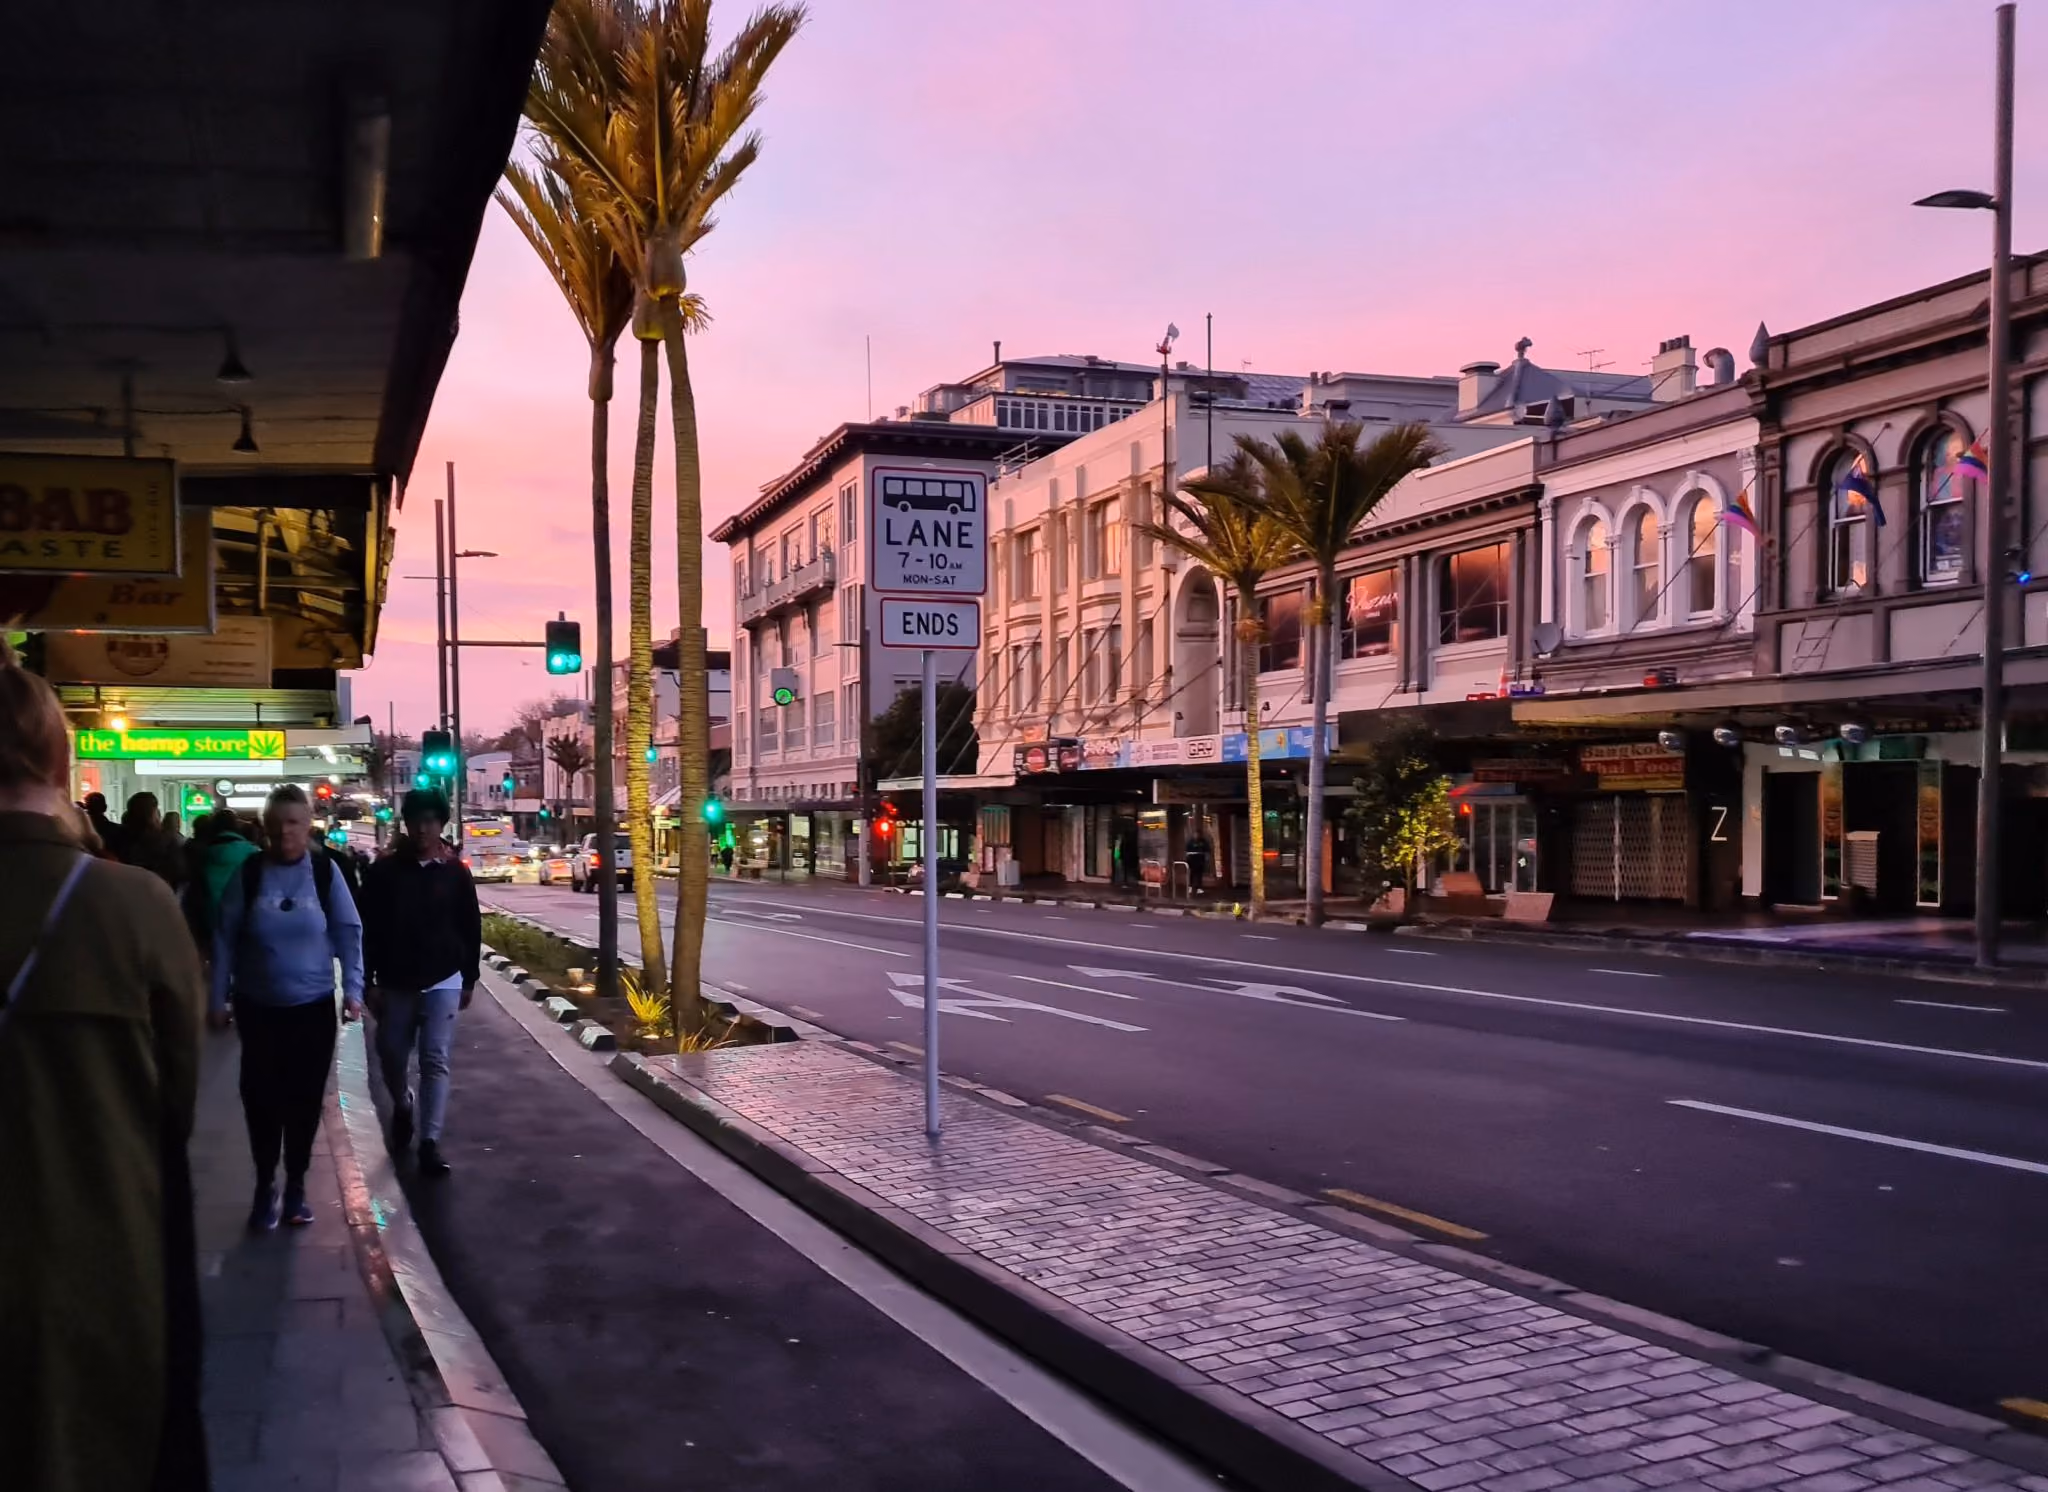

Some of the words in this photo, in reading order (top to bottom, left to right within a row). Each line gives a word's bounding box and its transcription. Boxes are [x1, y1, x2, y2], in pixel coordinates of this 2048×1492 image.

[885, 518, 974, 549] LANE
[903, 575, 957, 586] MON-SAT
[107, 584, 183, 605] Bar
[902, 611, 959, 636] ENDS
[80, 733, 116, 753] the
[120, 732, 190, 755] hemp
[194, 735, 248, 753] store
[1582, 761, 1625, 774] Thai
[1633, 759, 1682, 773] Food
[1710, 806, 1728, 841] Z
